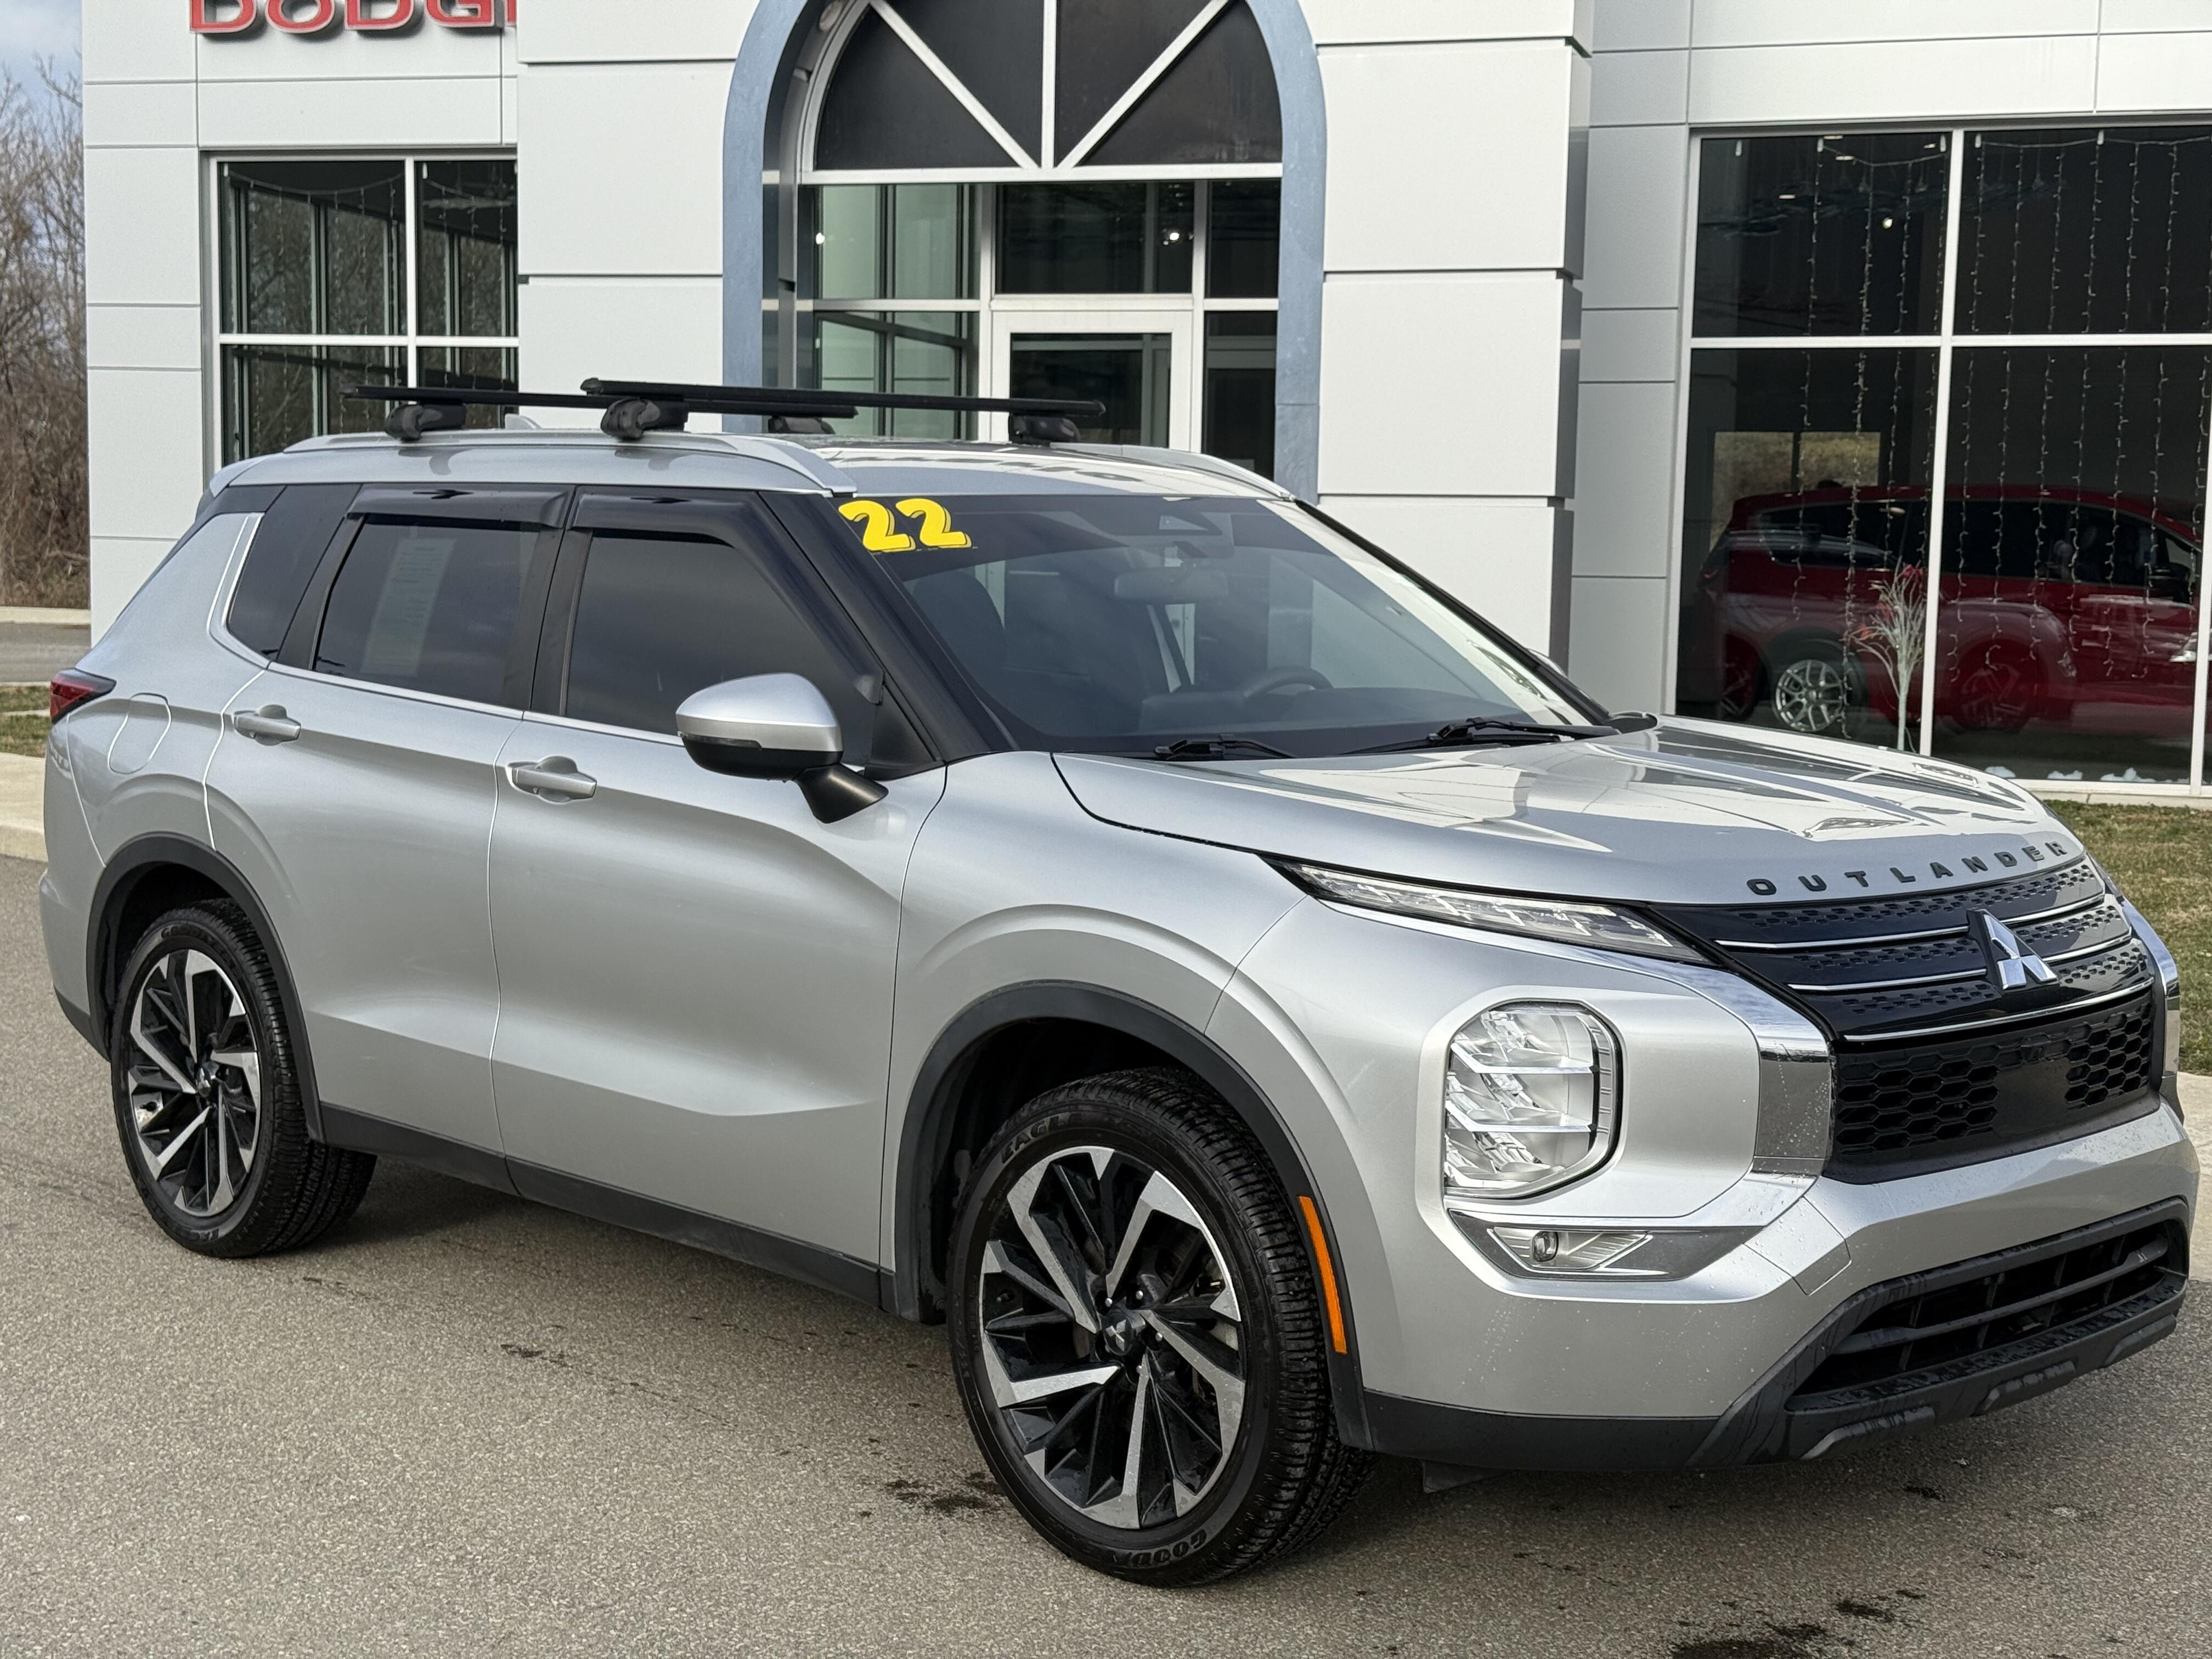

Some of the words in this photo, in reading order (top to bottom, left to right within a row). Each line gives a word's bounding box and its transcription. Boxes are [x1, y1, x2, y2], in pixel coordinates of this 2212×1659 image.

[190, 0, 516, 34] DODG
[838, 498, 973, 552] 22
[1747, 840, 2068, 896] OUTLANDER
